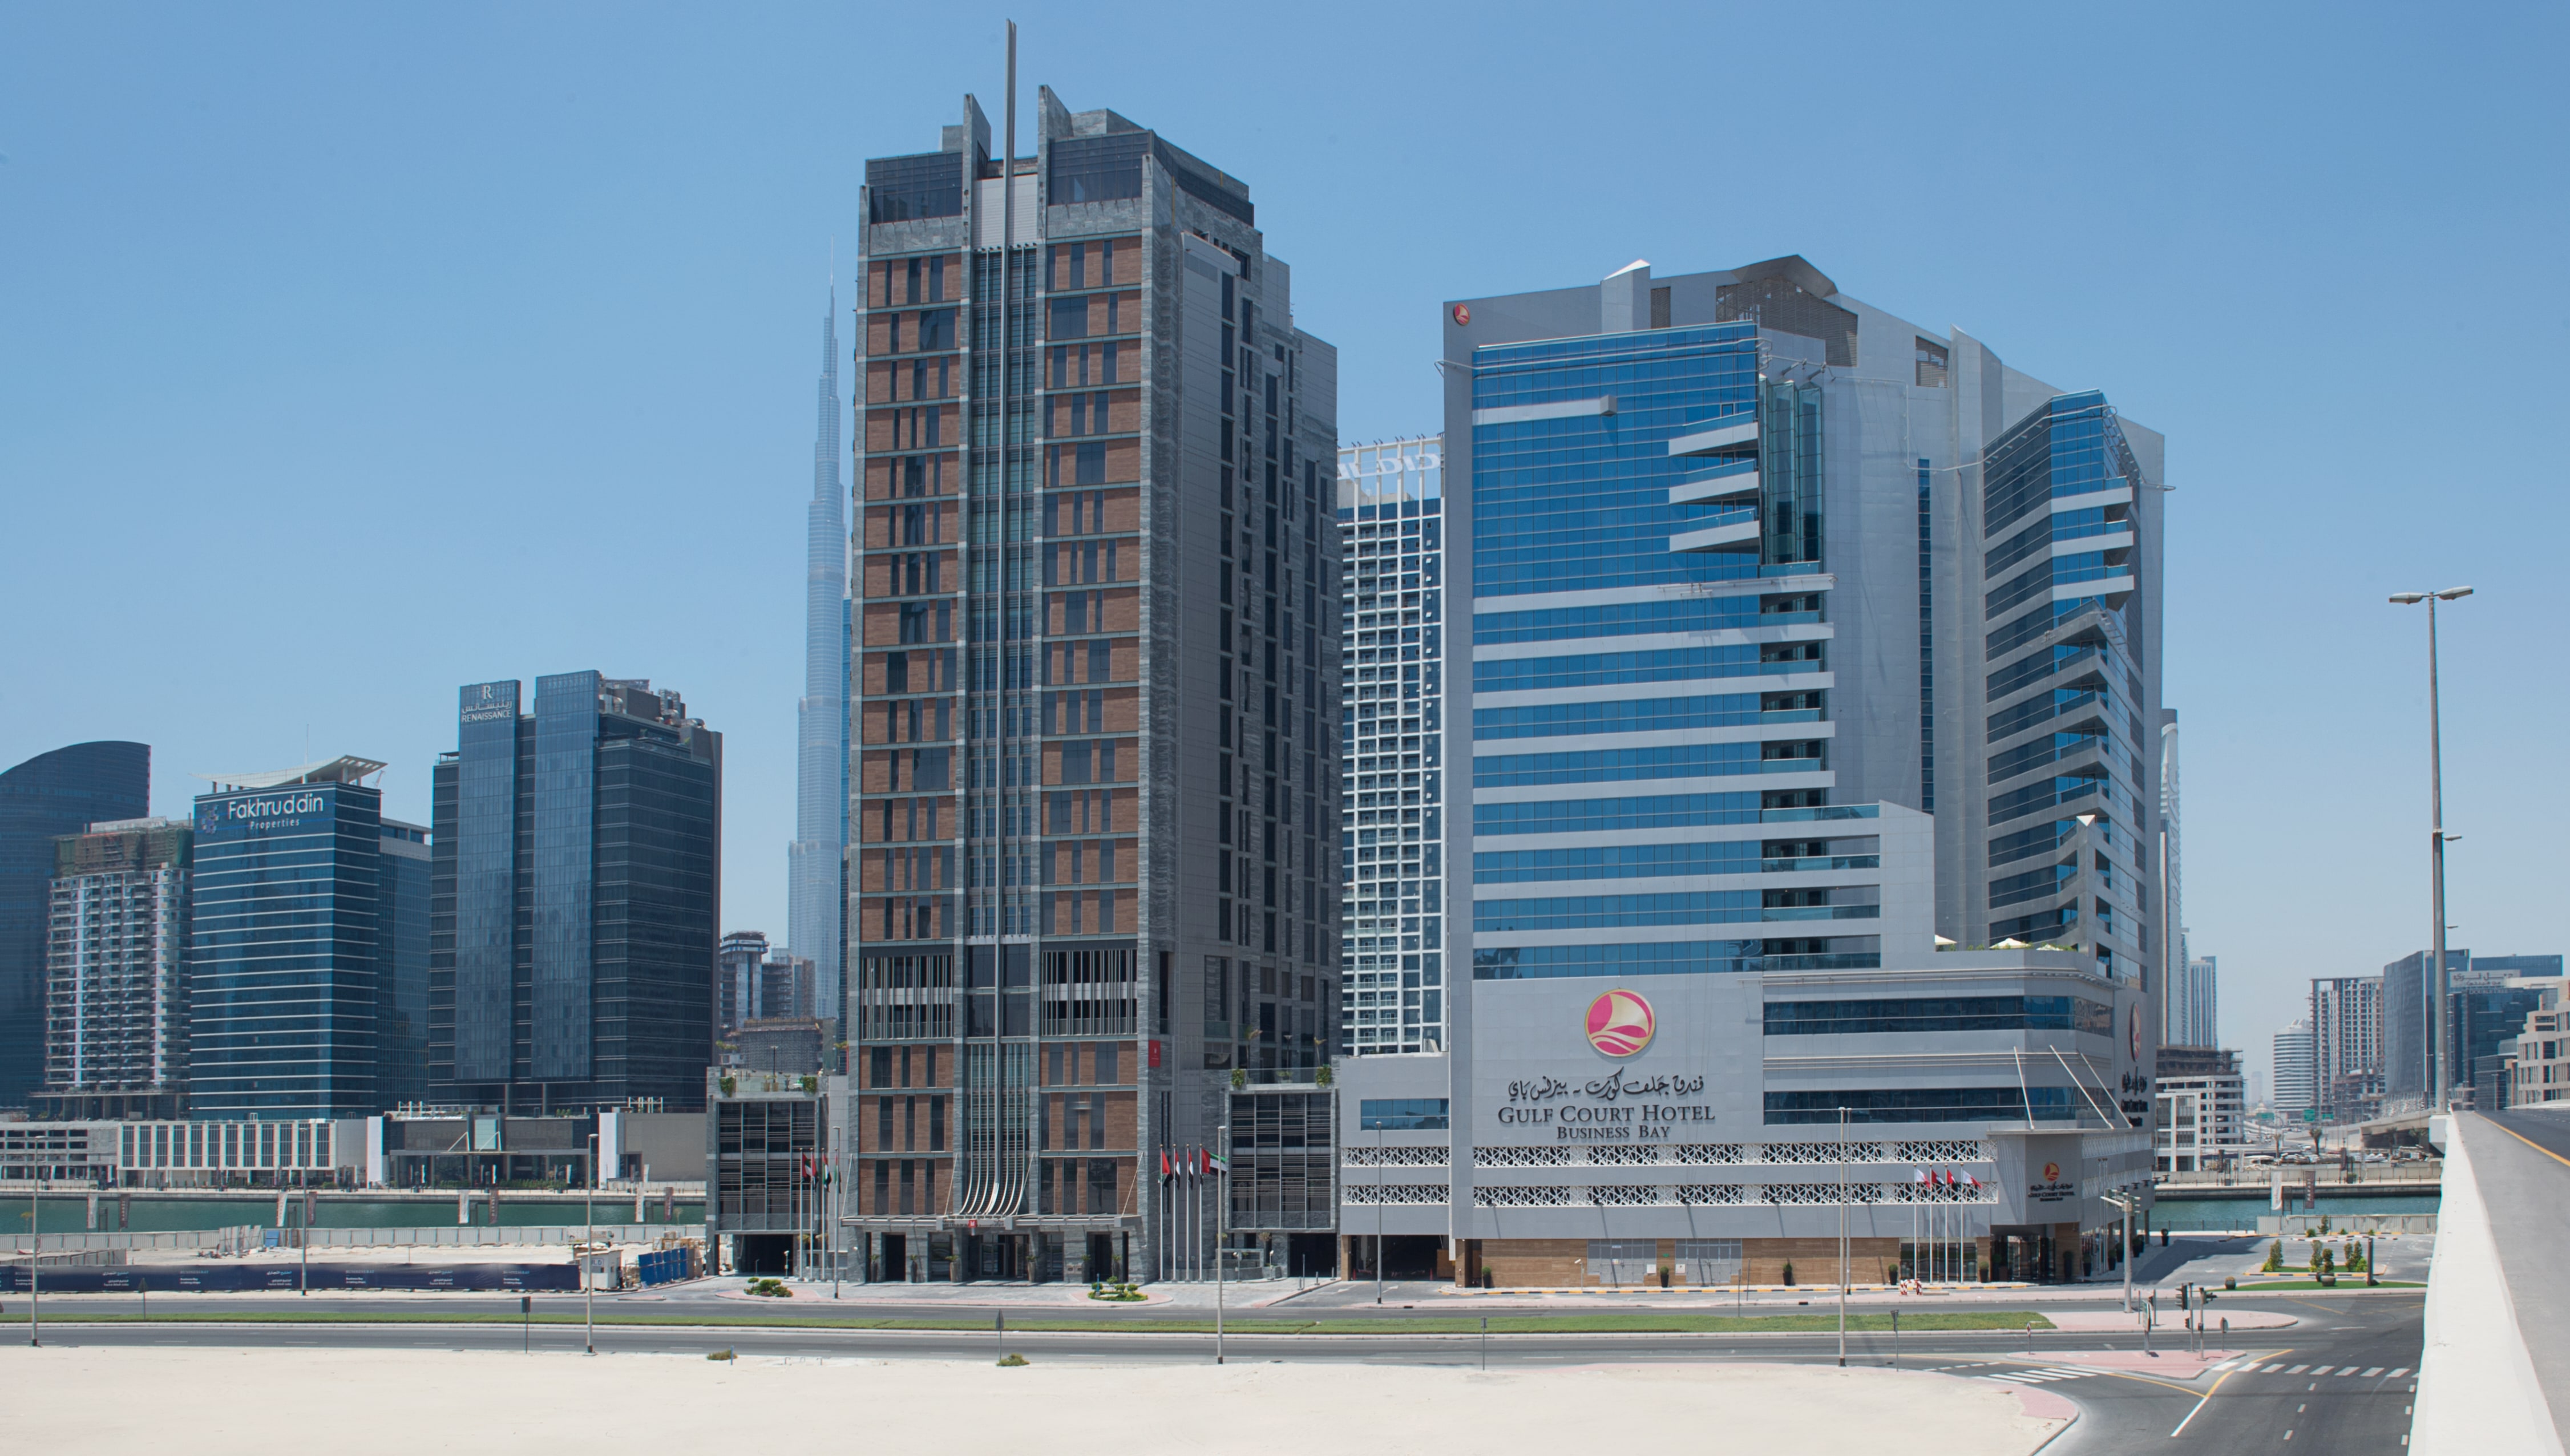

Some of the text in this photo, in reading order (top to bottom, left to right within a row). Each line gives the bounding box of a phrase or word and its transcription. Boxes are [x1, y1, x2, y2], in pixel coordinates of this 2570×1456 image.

[483, 685, 492, 699] R
[462, 710, 512, 723] RENAISSANCE
[228, 793, 324, 820] Fakhruddin
[250, 818, 300, 830] Properties
[1530, 1075, 1568, 1100] بيزنس
[1672, 1075, 1704, 1095] فندق
[1498, 1104, 1716, 1123] GULF COURT HOTEL
[1557, 1125, 1671, 1139] BUSINESS BAY
